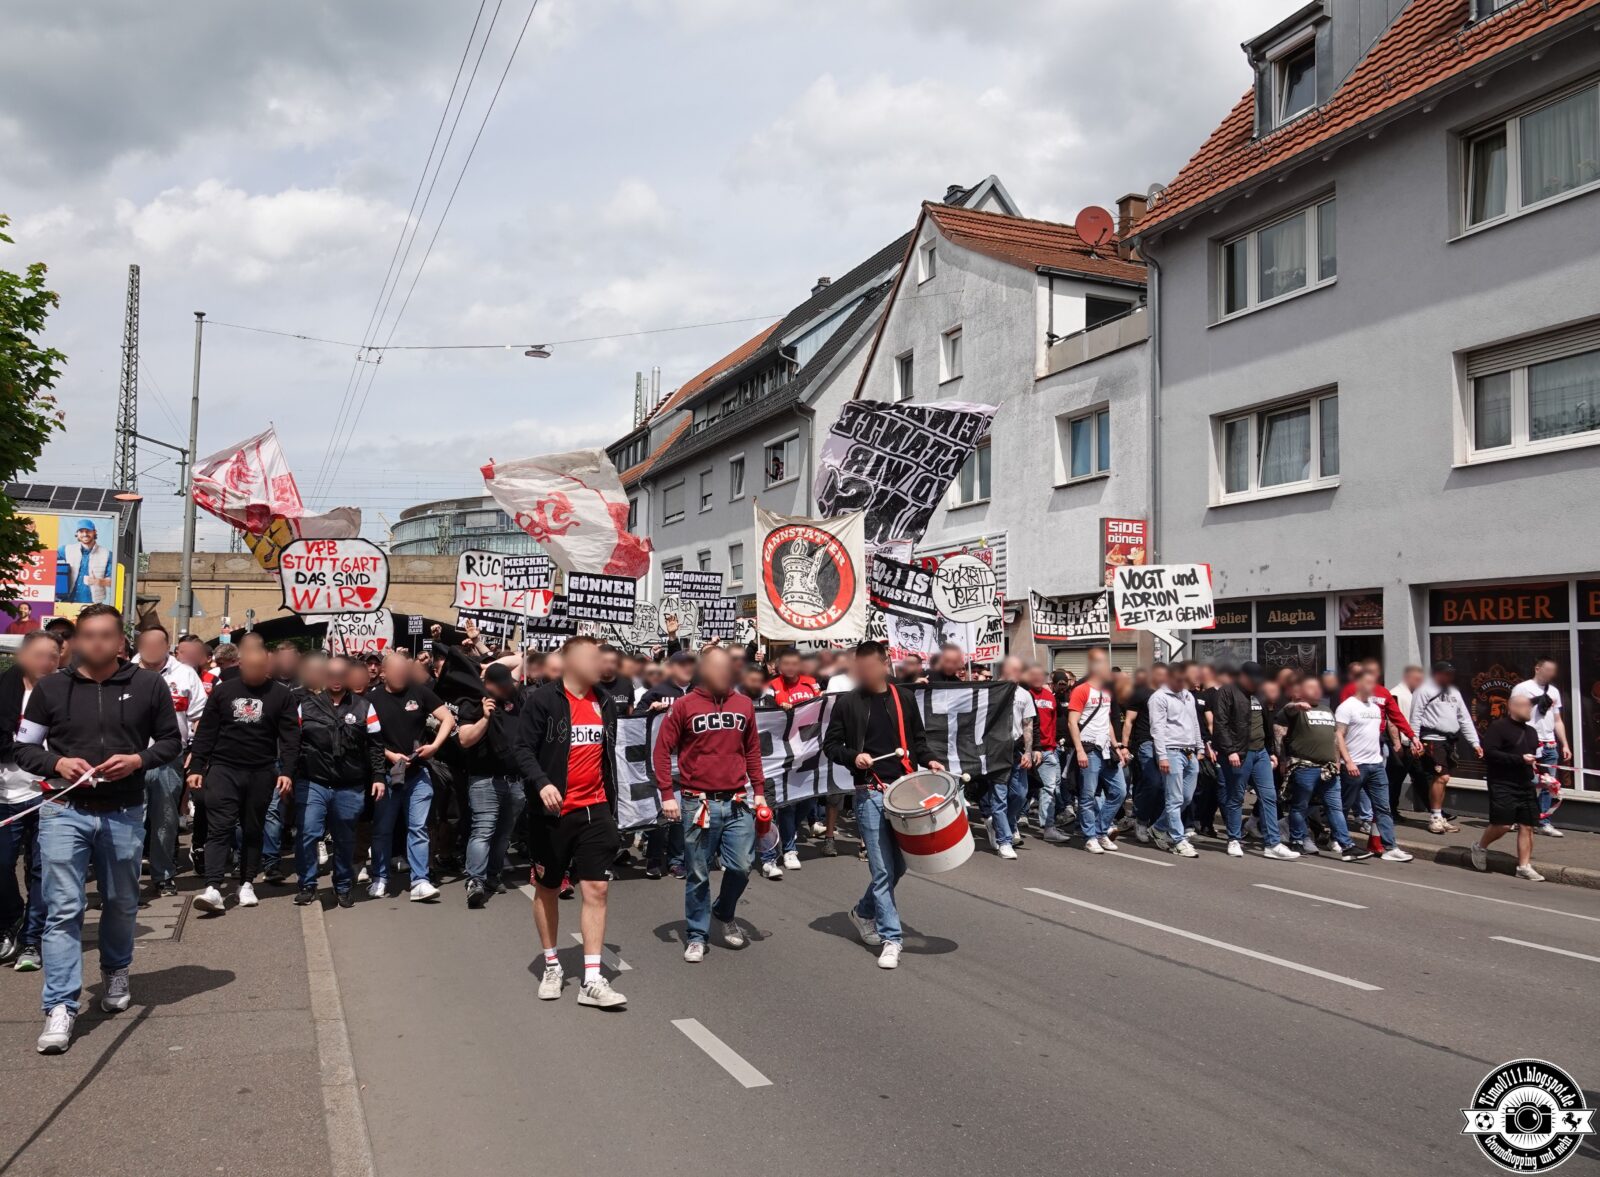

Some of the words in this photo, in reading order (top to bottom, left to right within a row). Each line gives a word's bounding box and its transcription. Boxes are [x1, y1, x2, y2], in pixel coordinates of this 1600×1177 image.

[764, 527, 846, 567] CANNSTATTER
[282, 553, 381, 573] STUTTGART
[504, 557, 548, 567] MESCHKE
[295, 571, 326, 587] DAS
[504, 575, 549, 590] MAUL
[569, 576, 634, 595] GÖNNER
[683, 573, 721, 584] GÖNNER
[1120, 568, 1166, 590] VOGT
[1172, 568, 1200, 586] und
[569, 593, 584, 603] DU
[587, 594, 634, 608] FALSCHE
[681, 592, 720, 600] SCHLANGE
[705, 599, 736, 609] VOGT
[1121, 588, 1179, 609] ADRION
[568, 606, 633, 622] SCHLANGE
[704, 609, 735, 621] UND
[779, 605, 843, 628] KURVE
[1175, 603, 1213, 623] GEHN!
[1267, 608, 1316, 625] Alagha
[1443, 595, 1554, 622] BARBER
[703, 629, 734, 639] RAUS
[976, 645, 1000, 657] ETZT!
[692, 712, 746, 734] CC97
[570, 725, 603, 743] ebitel
